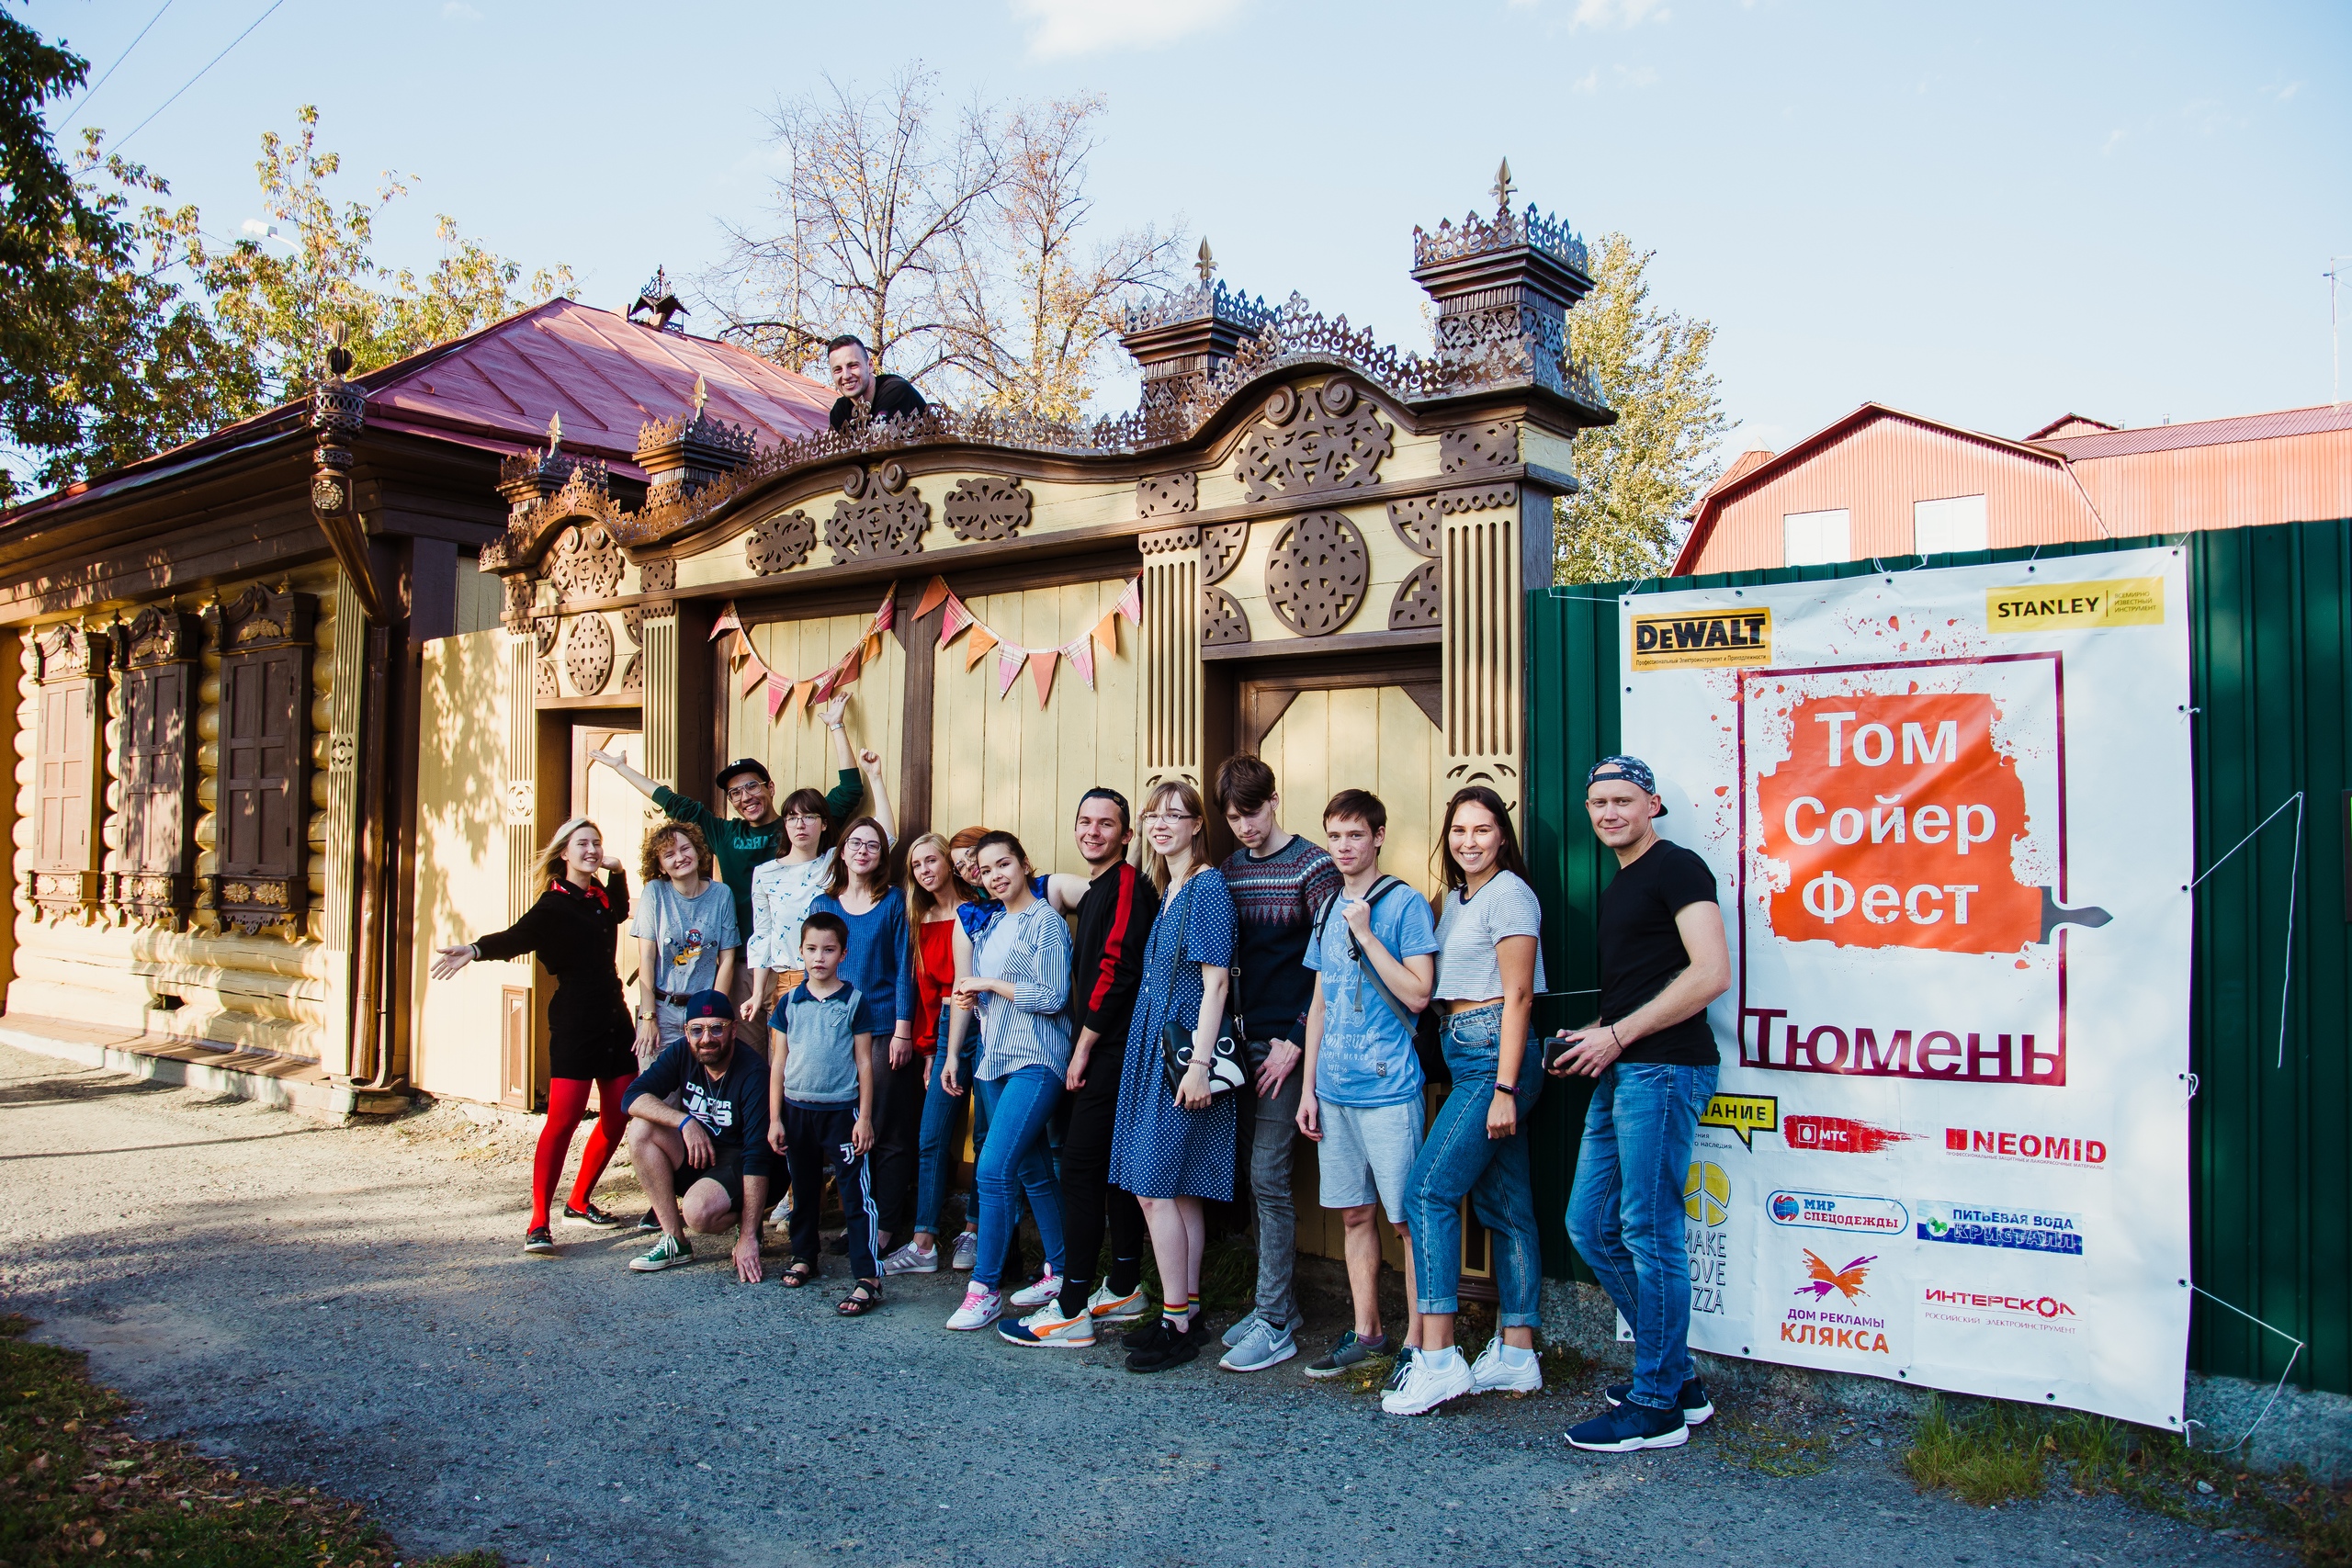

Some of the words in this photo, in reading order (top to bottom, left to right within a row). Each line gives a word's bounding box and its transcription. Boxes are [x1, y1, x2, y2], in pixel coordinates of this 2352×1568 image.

[1997, 597, 2099, 618] STANLEY
[1815, 711, 1957, 767] Том
[1784, 794, 1996, 855] Сойер
[1802, 871, 1979, 925] Фест
[1745, 1008, 2066, 1086] Тюмень
[1700, 1141, 1733, 1149] наследия
[1818, 1129, 1848, 1142] МТС
[1973, 1130, 2107, 1164] NEOMID
[1804, 1199, 1836, 1212] МИР
[1804, 1211, 1898, 1228] СПЕЦОДЕЖДЫ
[1953, 1209, 2029, 1225] ПИТЬЕВАЯ
[2033, 1215, 2074, 1230] ВОДА
[1953, 1222, 2075, 1249] КРИСТАЛЛ
[1689, 1258, 1725, 1286] OVE
[1692, 1286, 1724, 1314] ZZA
[1926, 1289, 2076, 1318] ИНТЕРСКОЛ
[1787, 1308, 1815, 1320] ДОМ
[1820, 1312, 1884, 1328] РЕКЛАМЫ
[1925, 1312, 1980, 1324] РОССИЙСКИЙ
[1985, 1318, 2075, 1334] ЭЛЕКТРОИНСТРУМЕНТ
[1781, 1322, 1889, 1354] КЛЯКСА
